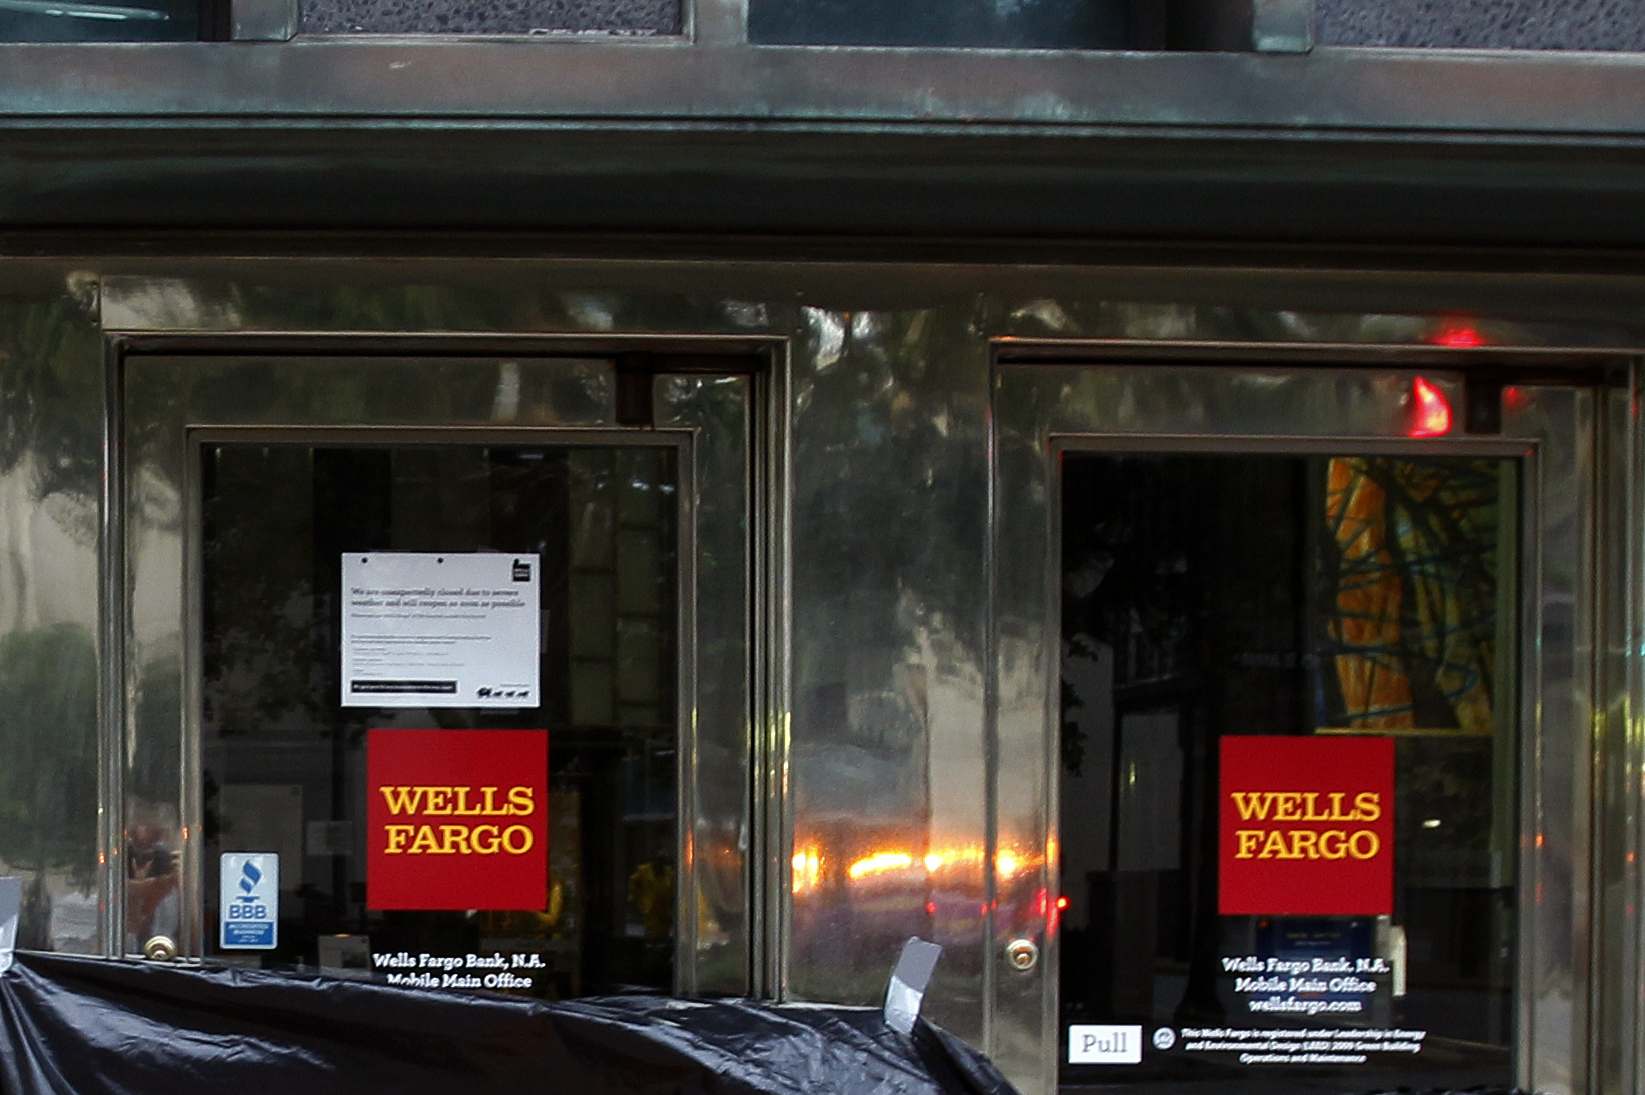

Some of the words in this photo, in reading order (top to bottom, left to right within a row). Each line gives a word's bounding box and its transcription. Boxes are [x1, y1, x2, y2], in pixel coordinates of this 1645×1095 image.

[380, 787, 534, 815] WELLS
[1231, 793, 1380, 821] WELLS
[385, 825, 533, 854] FARGO
[1235, 831, 1379, 859] FARGO
[230, 905, 267, 919] BBB
[373, 952, 416, 967] Wells
[419, 954, 463, 970] Fargo
[466, 953, 509, 970] Bank,
[512, 954, 545, 967] N.A.
[1222, 957, 1265, 971] Wells
[1267, 958, 1310, 974] Fargo
[1311, 957, 1354, 972] Bank,
[1356, 957, 1390, 972] N.A.
[386, 973, 439, 988] Mobile
[442, 974, 481, 987] Main
[484, 973, 532, 987] Office
[1235, 976, 1287, 992] Mobile
[1289, 978, 1328, 992] Main
[1329, 977, 1376, 992] Office
[1249, 996, 1362, 1015] wellsfargo.com
[1082, 1032, 1128, 1053] Pull
